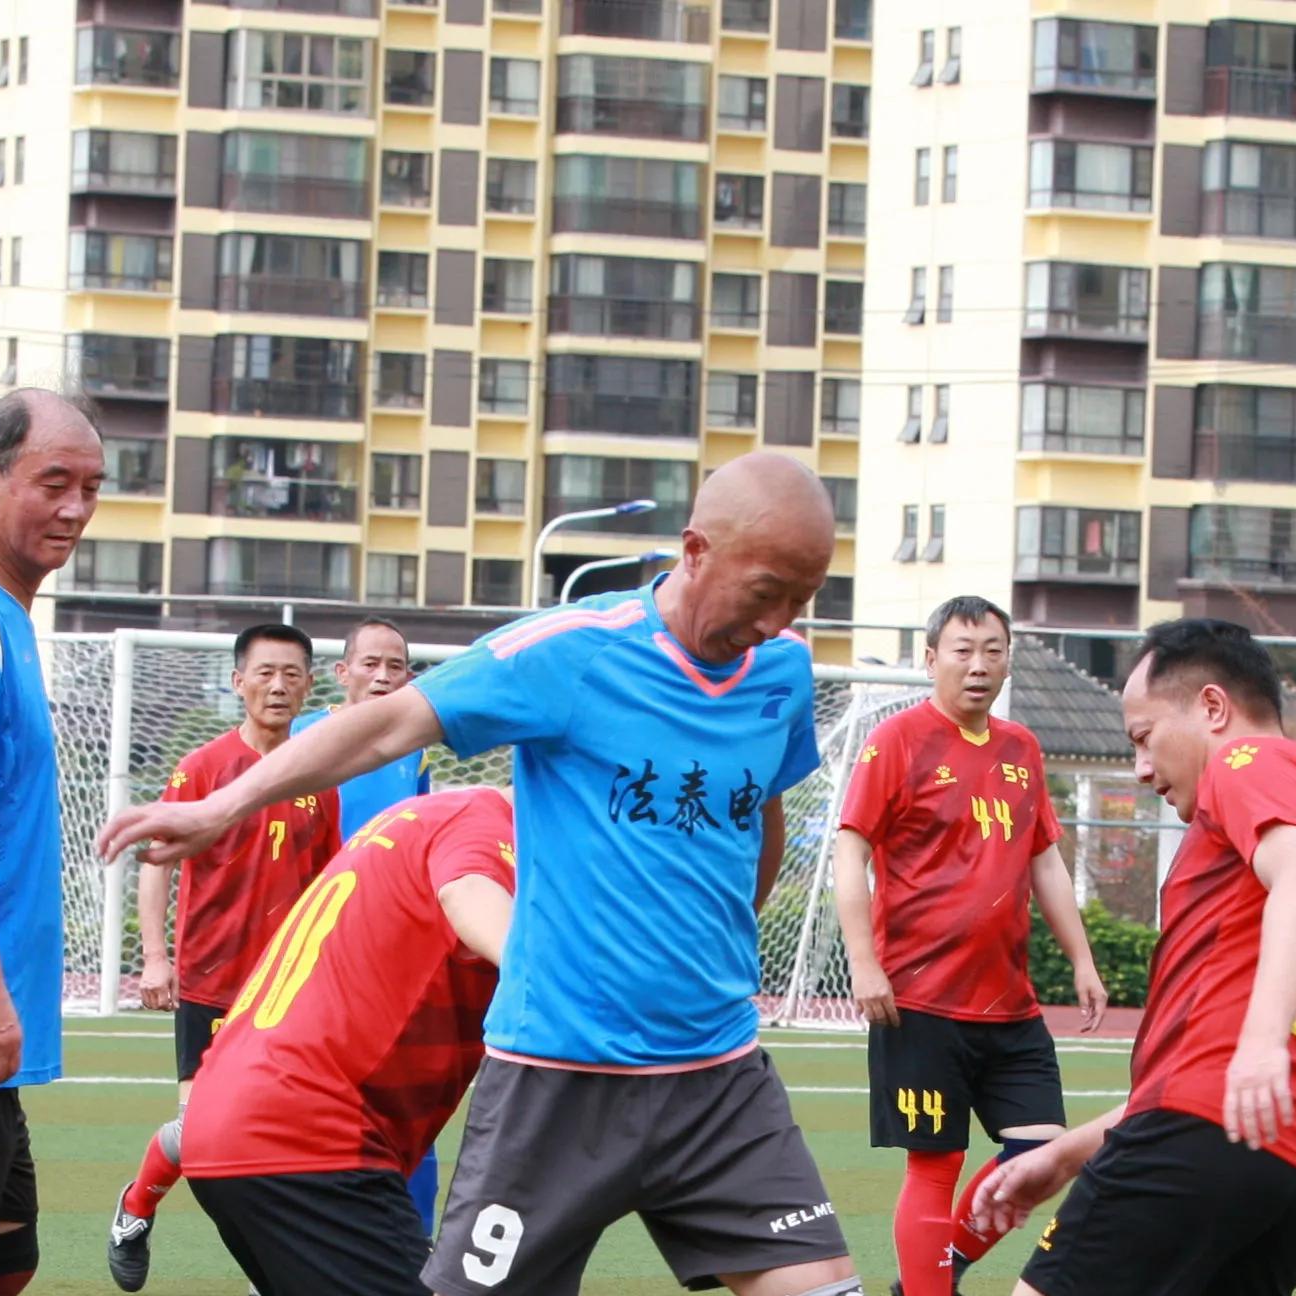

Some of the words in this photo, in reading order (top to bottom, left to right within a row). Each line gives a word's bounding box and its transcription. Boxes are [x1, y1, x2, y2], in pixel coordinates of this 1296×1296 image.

[268, 820, 286, 861] 7
[971, 795, 1014, 842] 44
[898, 1088, 946, 1134] 44
[770, 1202, 835, 1233] KELME
[462, 1203, 524, 1287] 9
